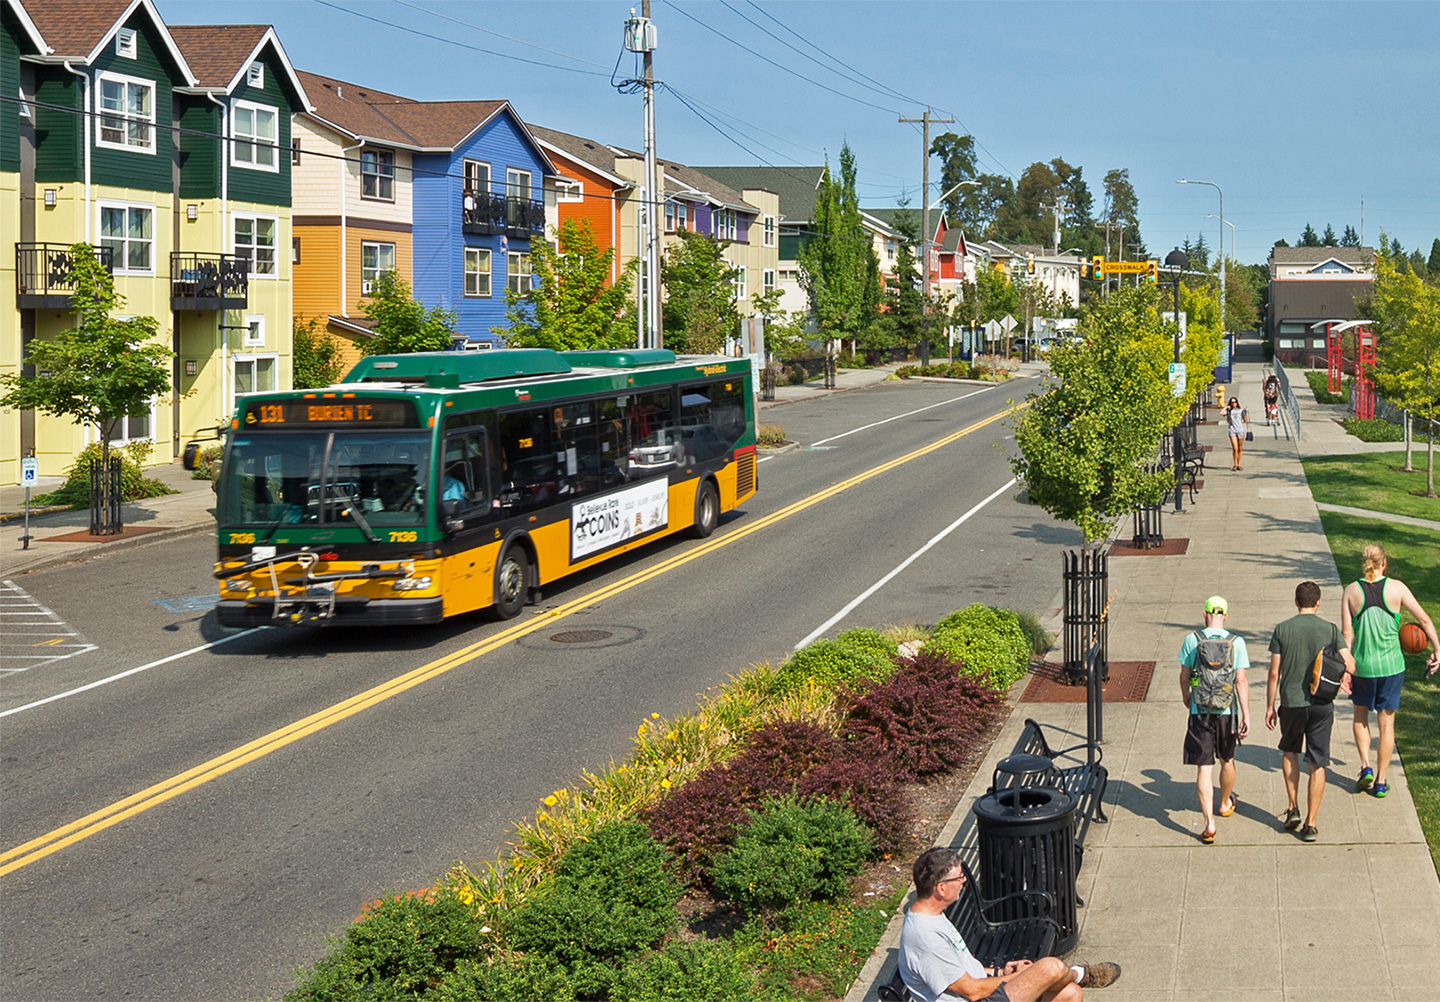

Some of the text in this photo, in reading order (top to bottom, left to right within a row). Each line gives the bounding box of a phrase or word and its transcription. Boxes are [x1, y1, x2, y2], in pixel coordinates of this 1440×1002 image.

[259, 404, 373, 423] 131 BURIEN TC
[589, 509, 619, 536] COINS
[229, 533, 256, 544] 7136
[388, 531, 418, 543] 7136
